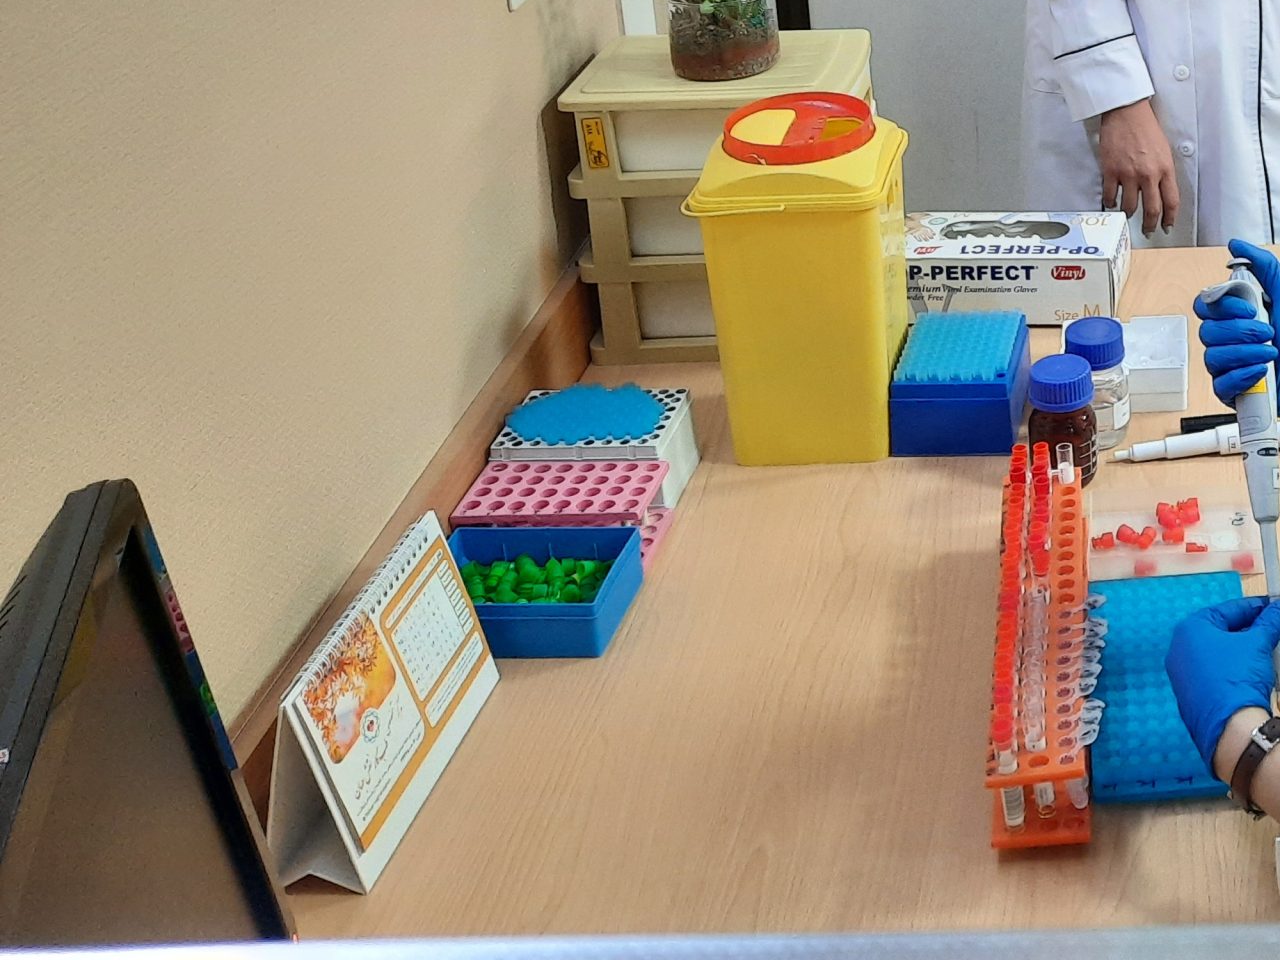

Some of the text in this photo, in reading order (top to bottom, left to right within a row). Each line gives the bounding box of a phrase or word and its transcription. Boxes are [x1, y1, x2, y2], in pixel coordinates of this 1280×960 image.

[960, 245, 1100, 255] OP-PERFECT
[908, 265, 1035, 281] P-PERFECT
[1052, 265, 1084, 281] Vinyl
[907, 284, 941, 294] emium
[963, 285, 1012, 294] Examination
[1013, 285, 1038, 294] Gloves
[927, 293, 944, 302] Free
[1054, 303, 1101, 322] Size M
